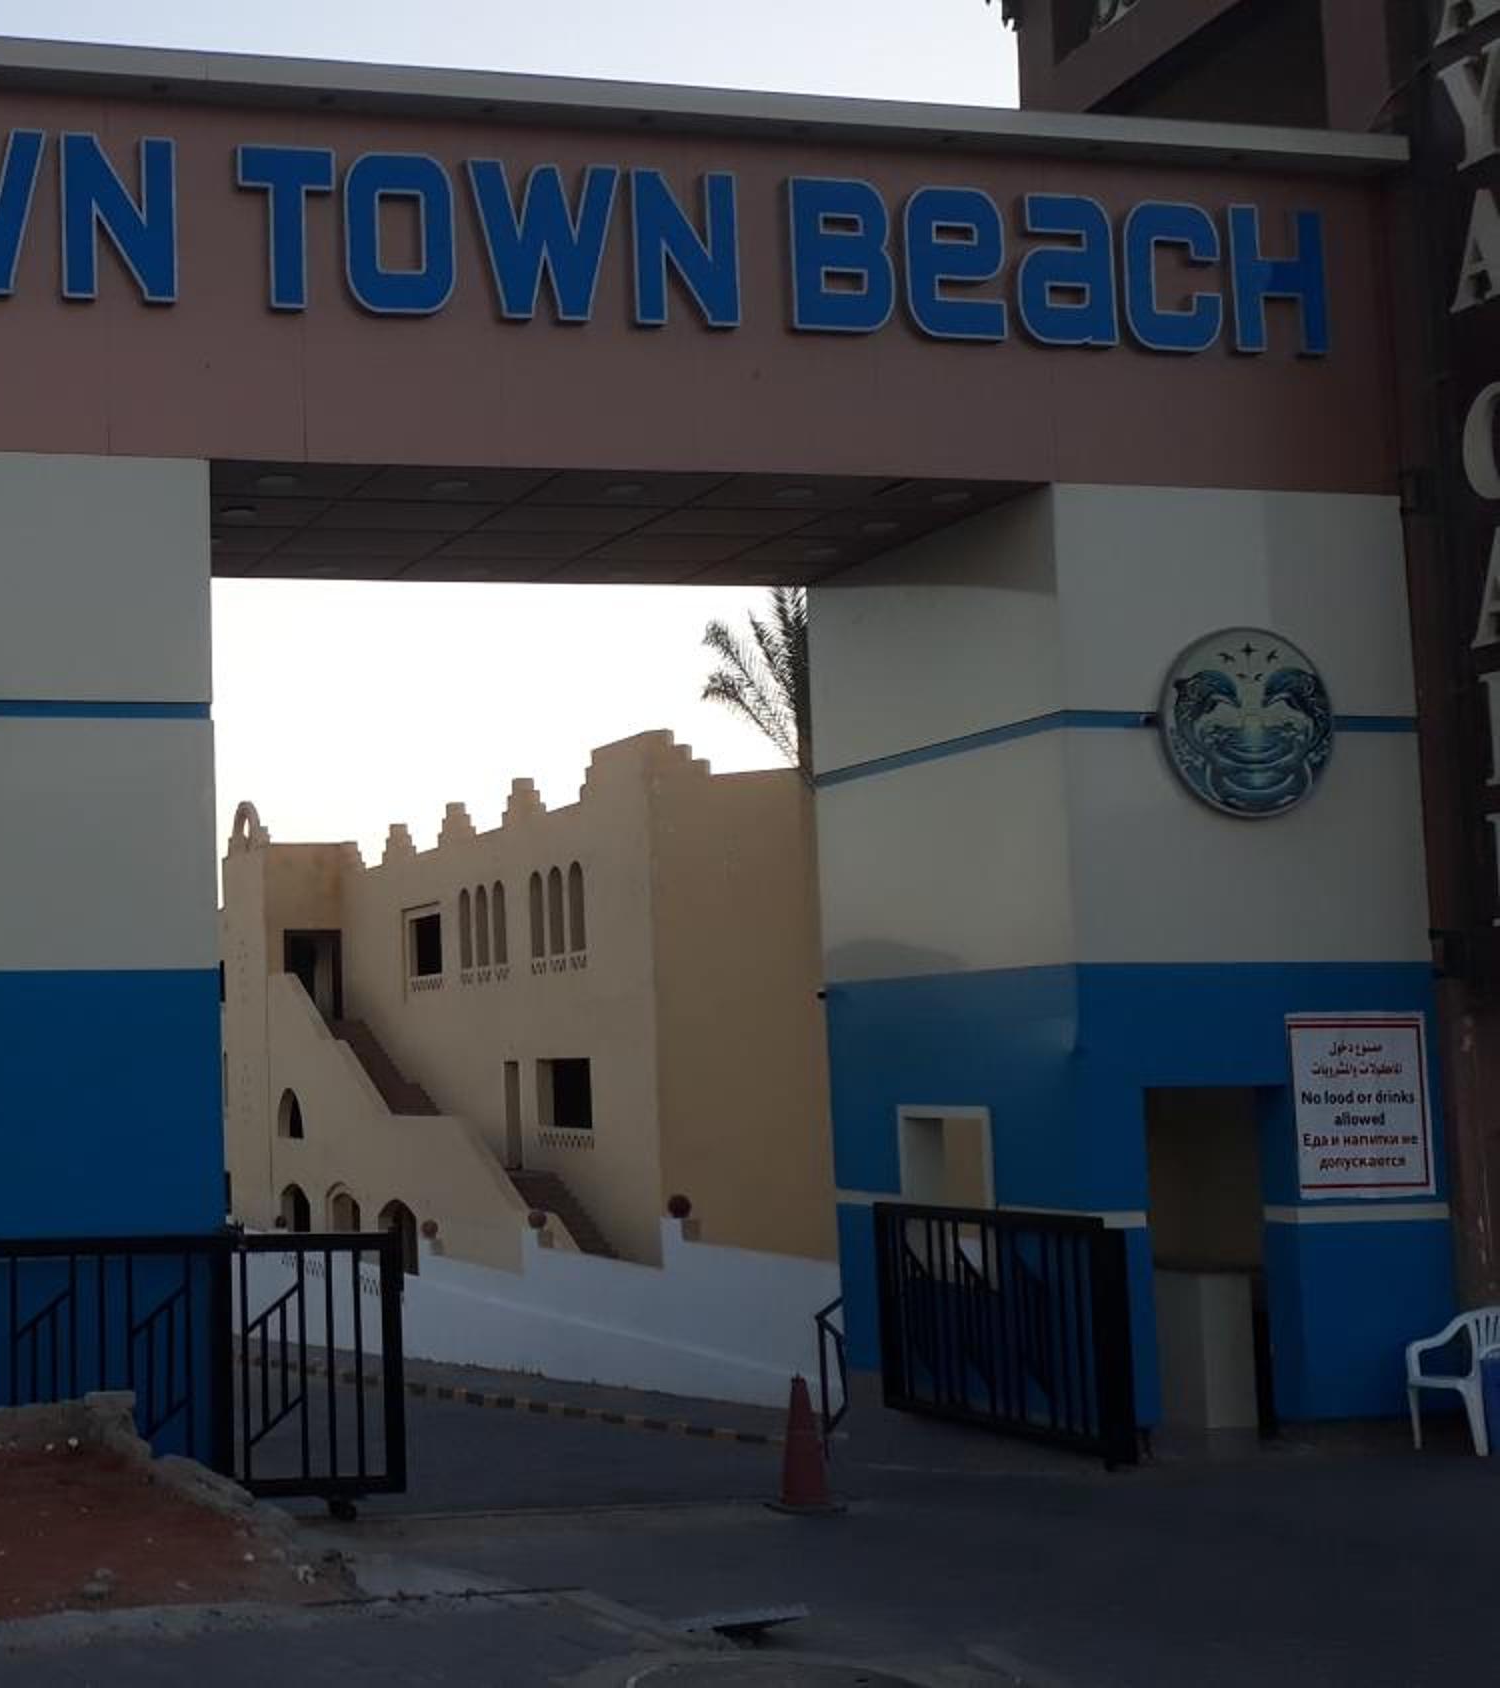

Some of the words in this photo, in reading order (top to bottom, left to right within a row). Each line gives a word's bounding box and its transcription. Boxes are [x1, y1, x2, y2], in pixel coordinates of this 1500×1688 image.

[235, 143, 741, 328] TOWN
[1328, 1040, 1354, 1057] دخول
[1355, 1040, 1383, 1057] ممنوع
[1300, 1090, 1321, 1105] No
[1357, 1092, 1372, 1104] or
[1375, 1089, 1415, 1105] drinks
[1333, 1111, 1386, 1127] allowed
[1302, 1132, 1329, 1150] Еда
[1331, 1135, 1340, 1147] и
[1343, 1134, 1399, 1147] напитки
